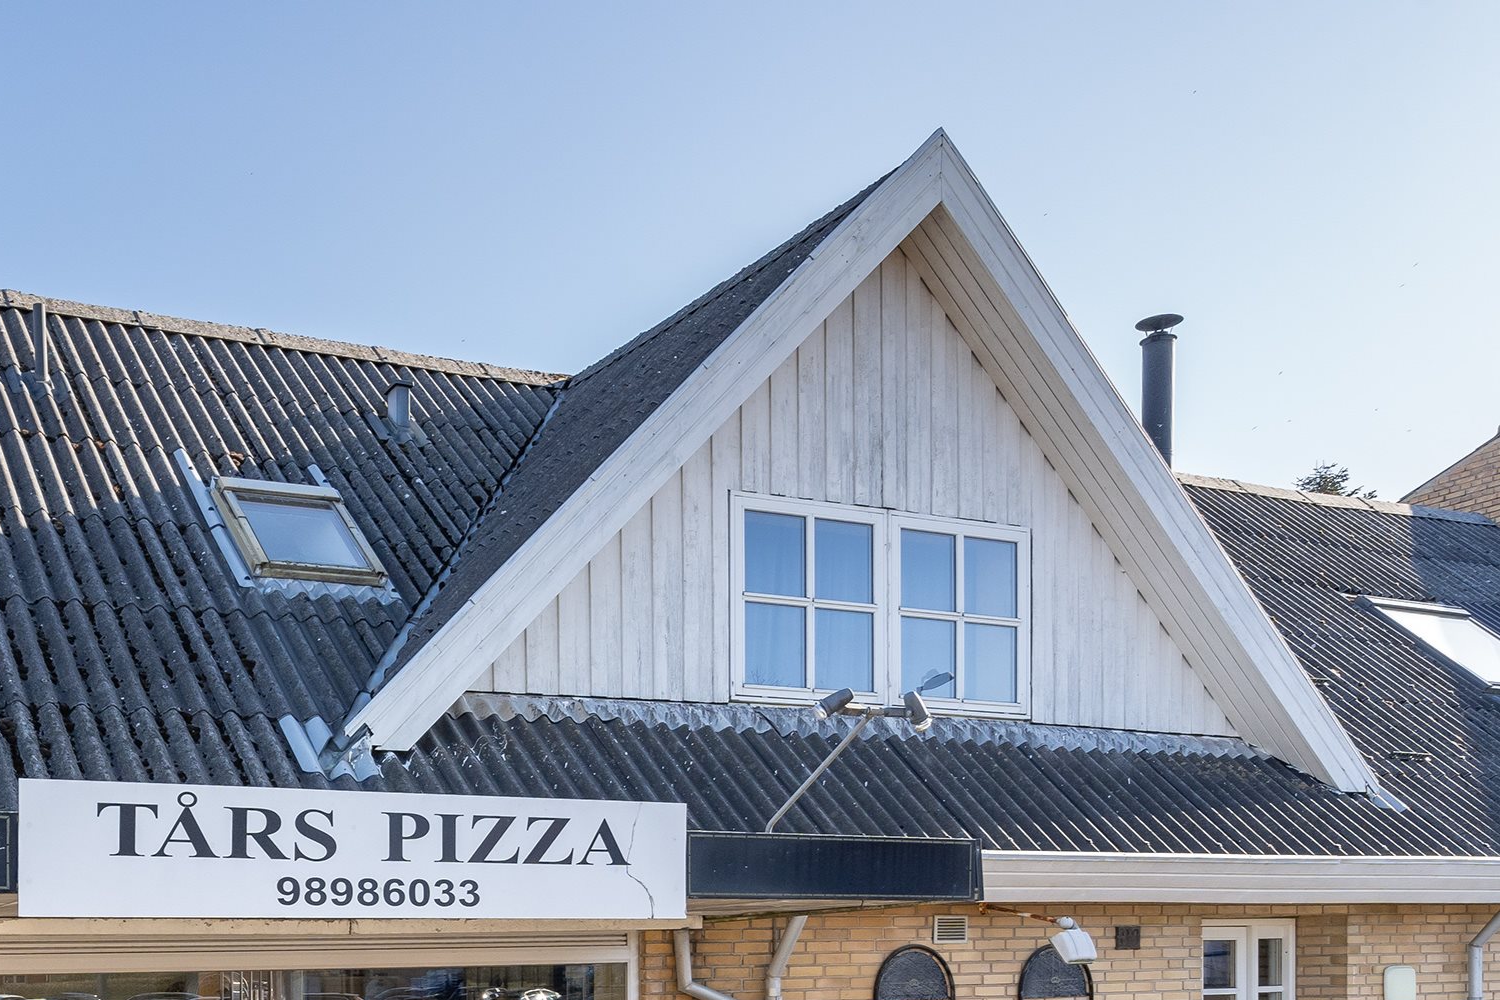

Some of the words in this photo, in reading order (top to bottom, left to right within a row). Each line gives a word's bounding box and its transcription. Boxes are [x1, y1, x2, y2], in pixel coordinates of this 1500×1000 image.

[97, 791, 338, 862] TÅRS
[380, 811, 632, 867] PIZZA
[276, 876, 481, 908] 98986033
